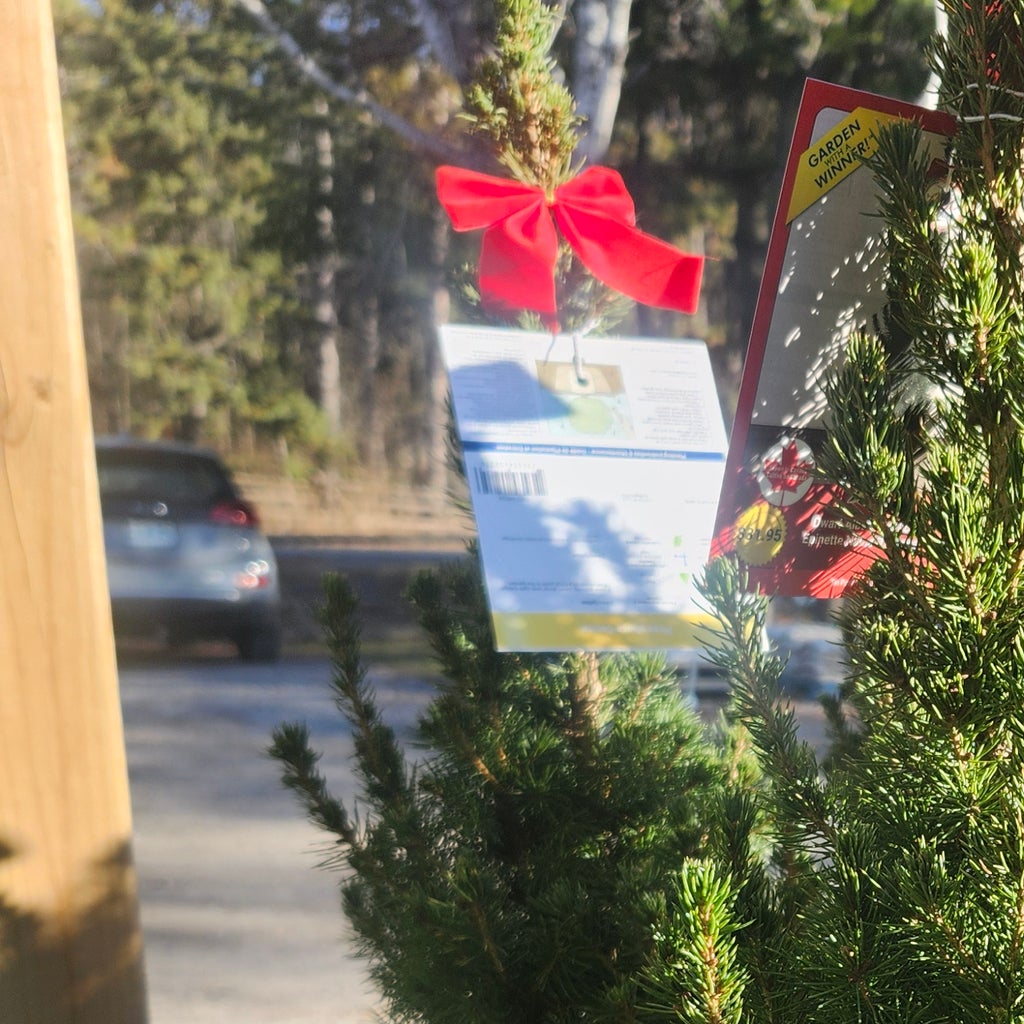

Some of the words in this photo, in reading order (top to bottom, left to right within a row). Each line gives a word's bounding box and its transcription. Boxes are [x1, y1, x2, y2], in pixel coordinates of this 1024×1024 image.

[808, 119, 861, 168] GARDEN
[814, 138, 871, 189] WINNER!
[824, 150, 844, 167] WITH
